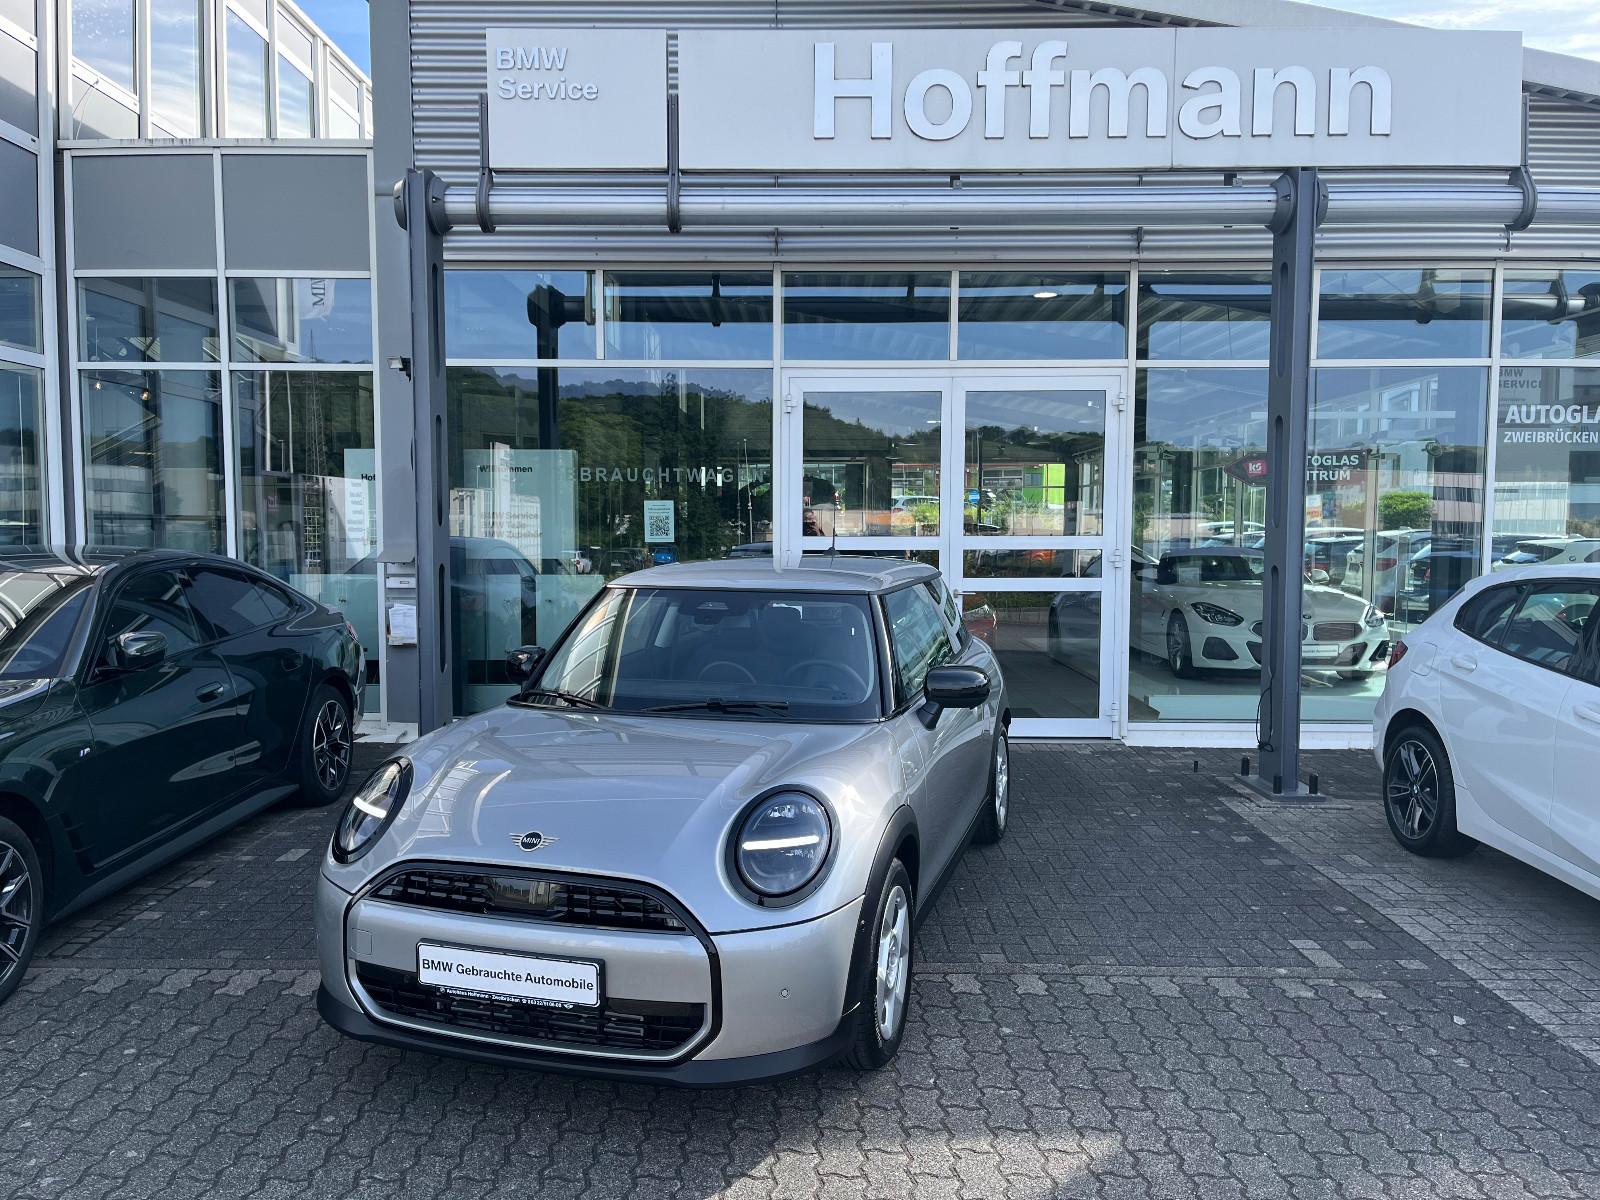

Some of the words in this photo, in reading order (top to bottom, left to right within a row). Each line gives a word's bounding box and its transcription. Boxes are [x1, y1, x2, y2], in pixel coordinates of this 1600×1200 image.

[496, 47, 567, 70] BMW
[499, 76, 599, 100] Service
[813, 40, 1392, 140] Hoffmann
[1503, 428, 1599, 443] ZWEIBRÜCKEN
[422, 958, 453, 973] BMW
[456, 963, 522, 982] Gebrauchte
[524, 972, 594, 991] Automobile
